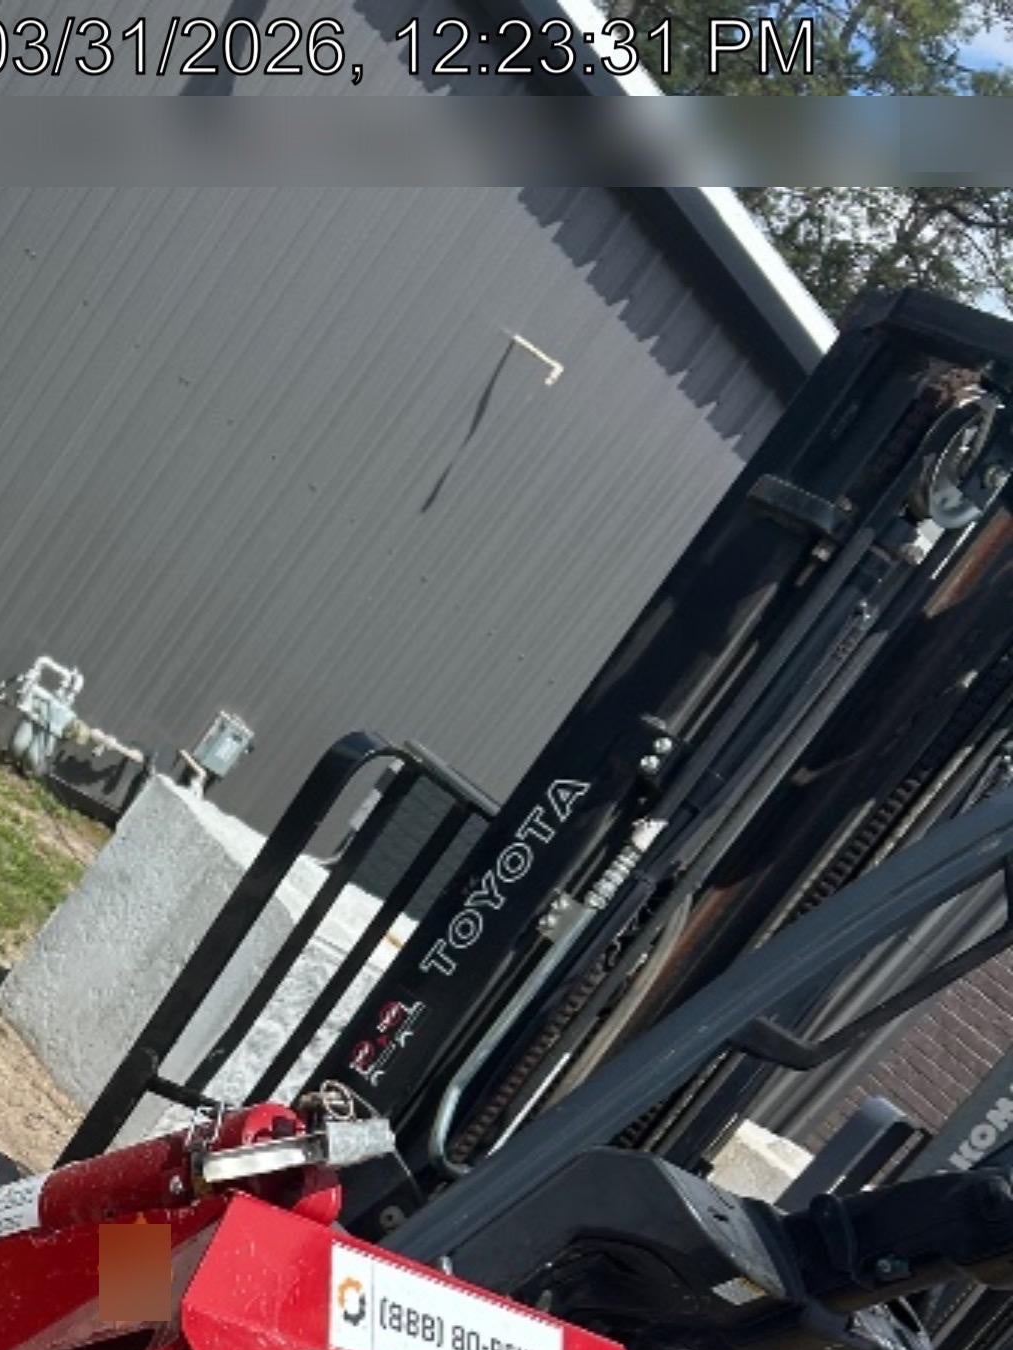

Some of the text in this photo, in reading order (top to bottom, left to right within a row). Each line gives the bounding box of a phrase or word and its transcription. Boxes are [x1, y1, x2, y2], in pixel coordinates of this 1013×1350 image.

[419, 778, 590, 976] TOYOTA
[949, 1083, 1013, 1171] KOM
[379, 1296, 445, 1349] (888)
